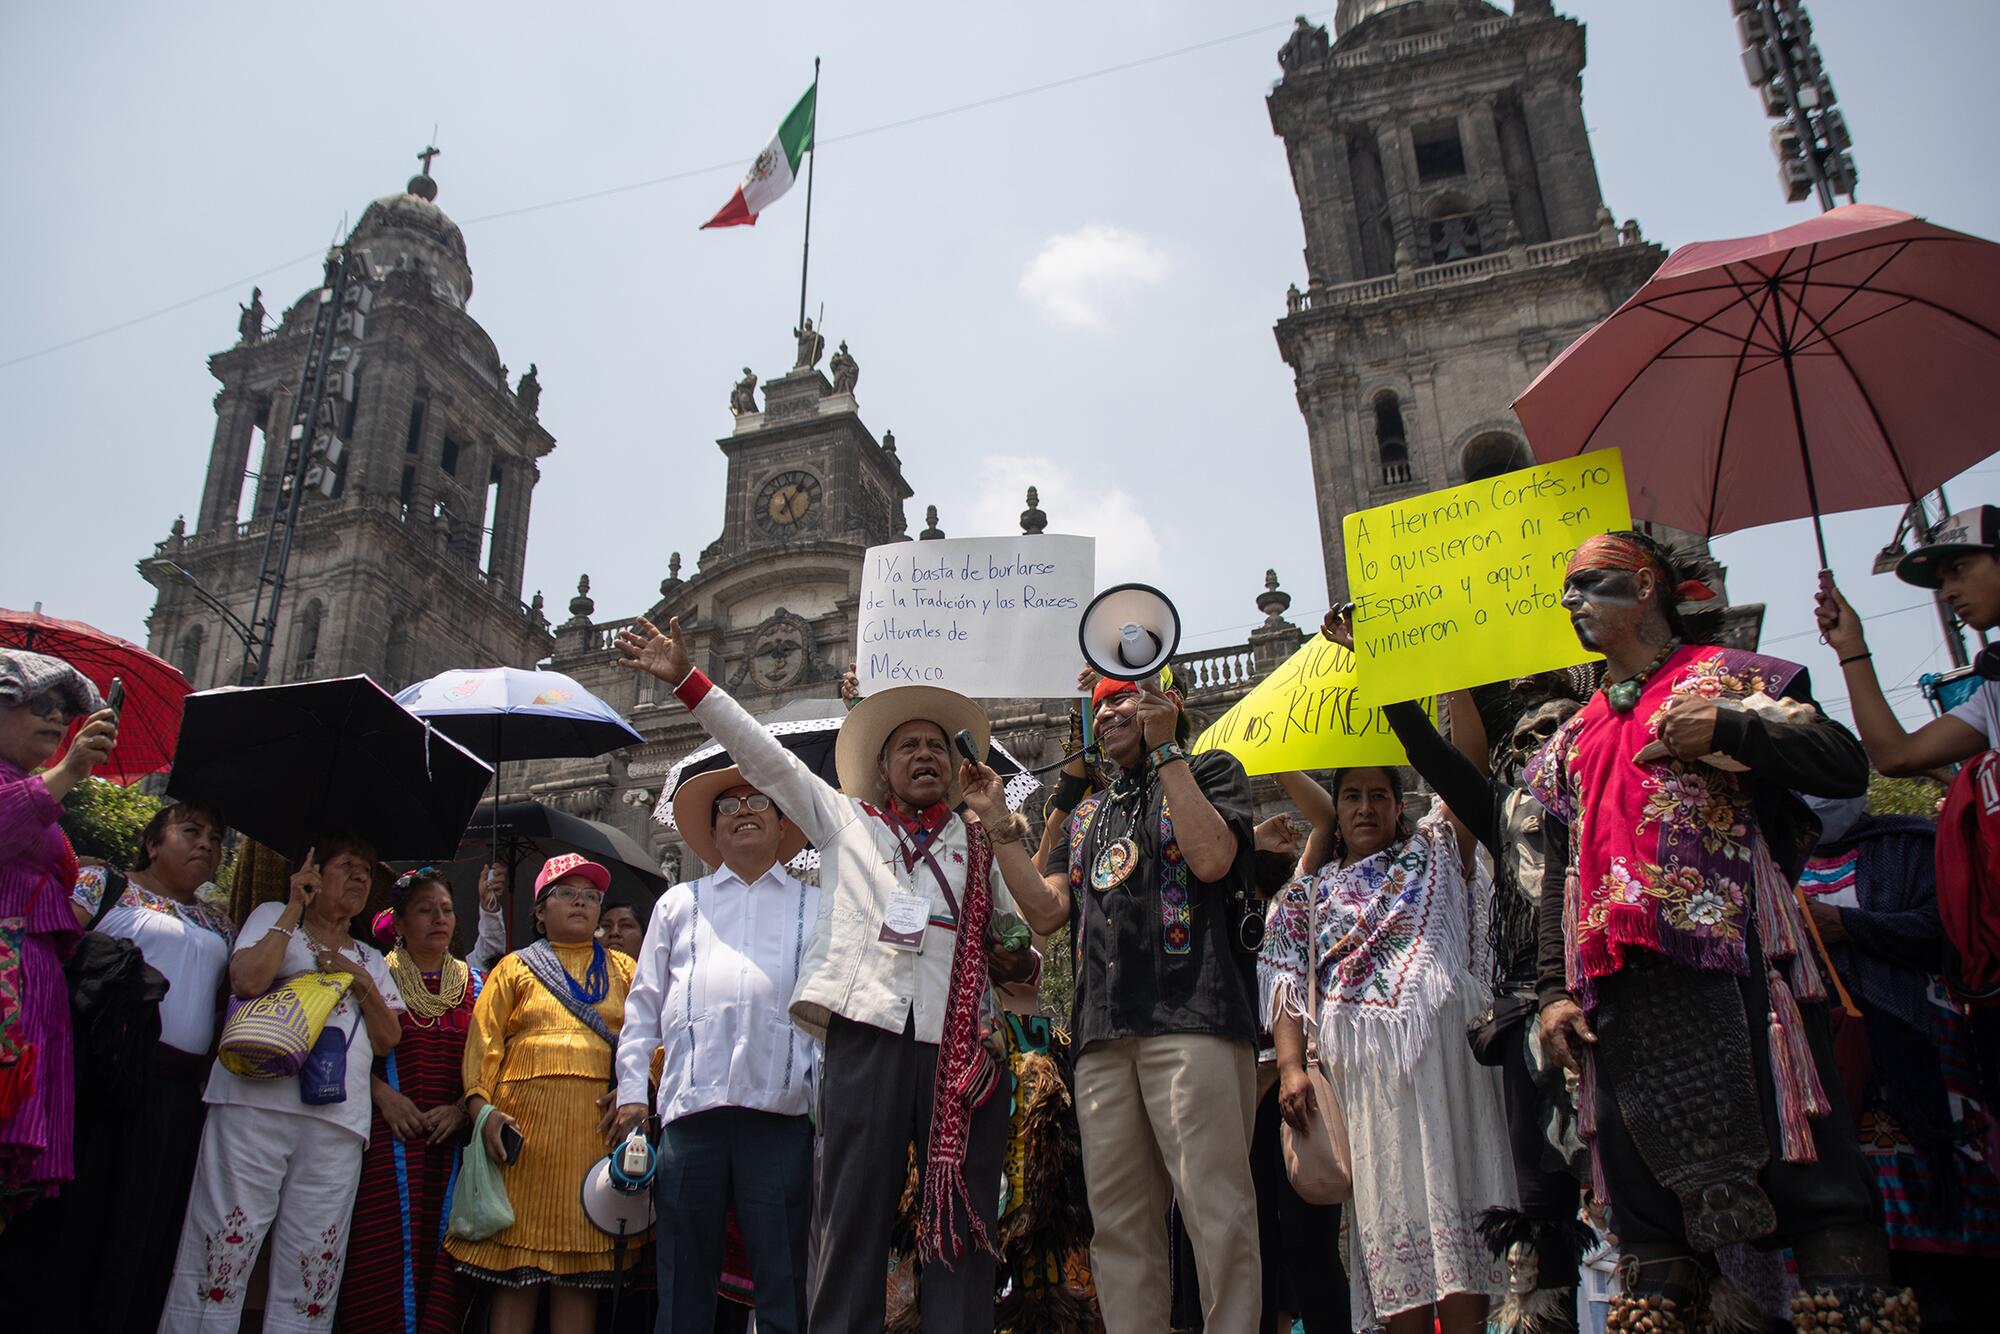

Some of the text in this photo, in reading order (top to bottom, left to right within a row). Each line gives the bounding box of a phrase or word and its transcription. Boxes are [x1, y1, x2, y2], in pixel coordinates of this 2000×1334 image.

[1357, 517, 1371, 548] A
[1391, 494, 1480, 538] Hernán
[1581, 467, 1609, 489] no
[1359, 506, 1591, 582] lo quisieron ni en
[911, 556, 954, 582] basta
[961, 554, 983, 581] de
[989, 553, 1055, 579] burlarse
[866, 584, 1078, 615] de la Tradición y las Raizes
[1355, 584, 1443, 624] España
[1460, 576, 1473, 604] y
[1487, 553, 1532, 592] aquí
[862, 617, 969, 643] Culturales de
[1365, 618, 1458, 659] vinieron
